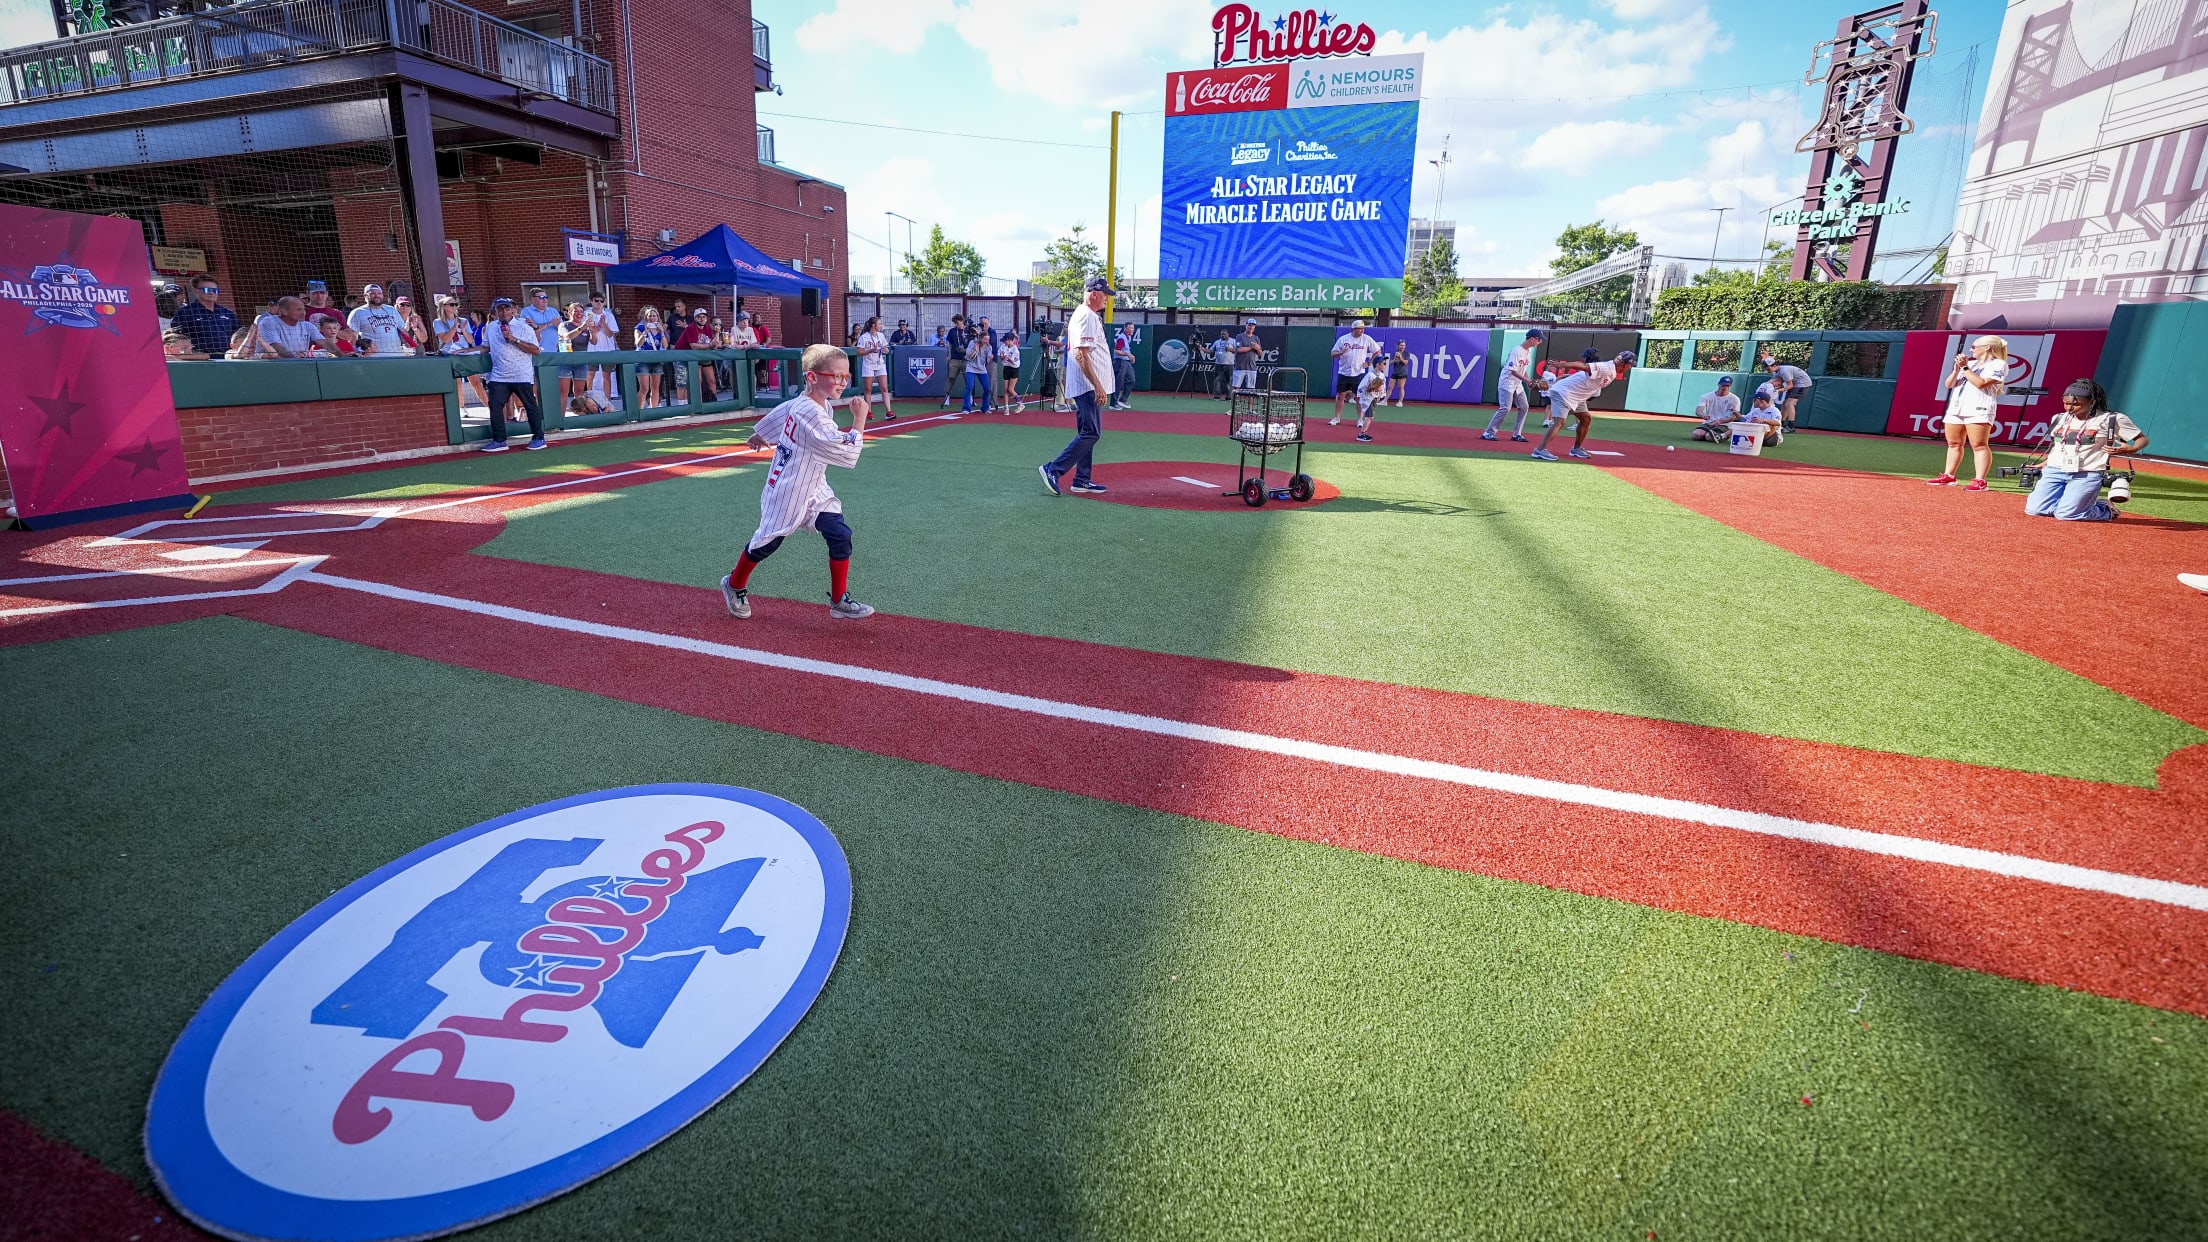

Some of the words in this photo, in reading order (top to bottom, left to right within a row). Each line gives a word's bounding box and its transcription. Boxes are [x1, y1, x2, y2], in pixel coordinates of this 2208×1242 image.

[1212, 3, 1376, 64] Phillies
[1331, 68, 1415, 85] NEMOURS
[1190, 73, 1277, 106] Coca-Cola
[1330, 85, 1380, 97] CHILDREN'S
[1381, 83, 1414, 94] HEALTH
[1231, 146, 1271, 161] Legacy
[1297, 141, 1328, 152] Phillies
[1290, 173, 1357, 196] LEGACY
[1186, 202, 1258, 224] MIRACLE
[1261, 200, 1328, 223] LEAGUE
[1331, 198, 1381, 221] GAME
[1769, 206, 1846, 227] Citizens
[1848, 196, 1910, 218] Bank
[1807, 219, 1857, 240] Park
[585, 246, 613, 258] ELEVATORS
[0, 280, 39, 299] ALL
[39, 283, 83, 302] STAR
[84, 285, 130, 304] GAME
[1205, 285, 1277, 302] Citizens
[1281, 284, 1328, 301] Bank
[1114, 327, 1142, 345] 34
[910, 358, 934, 367] MLB
[1909, 414, 2053, 442] TOOTA
[332, 820, 726, 1145] Phillies
